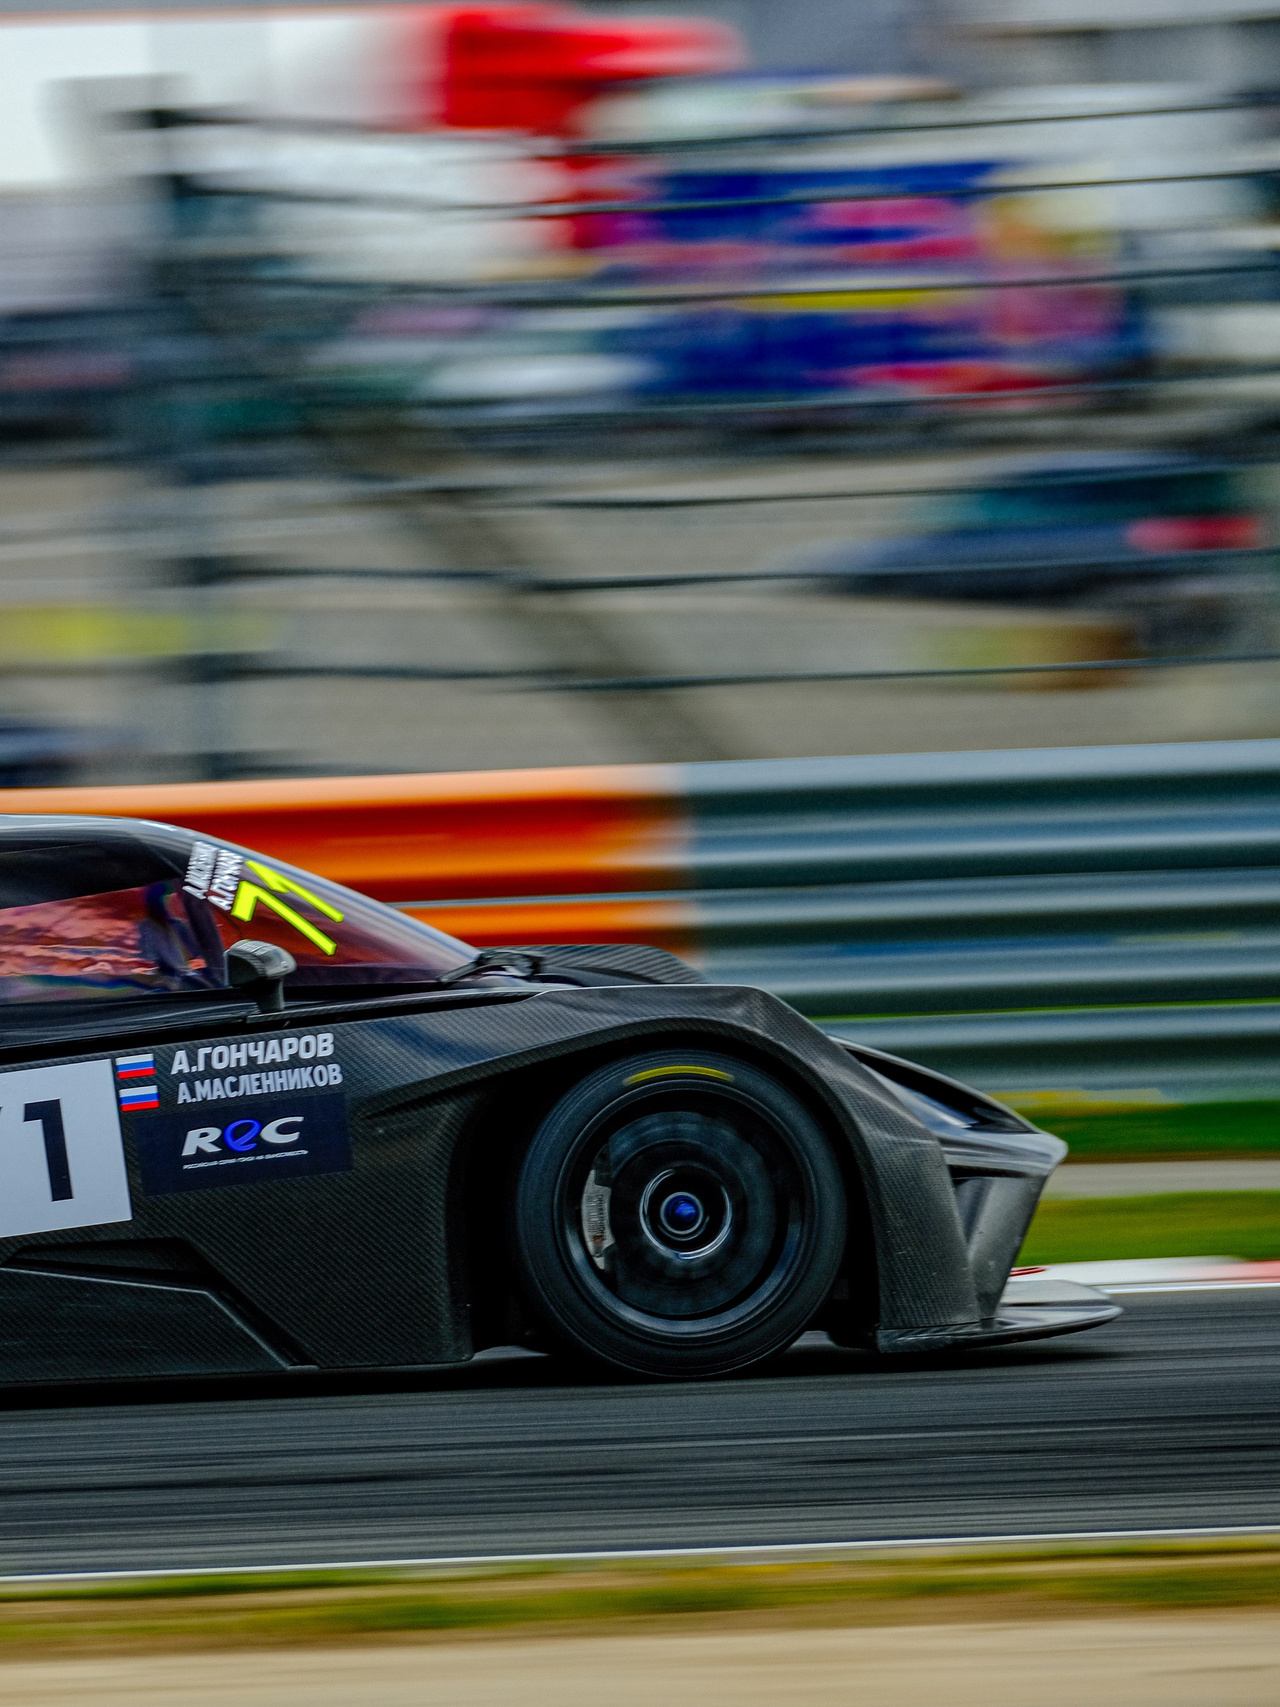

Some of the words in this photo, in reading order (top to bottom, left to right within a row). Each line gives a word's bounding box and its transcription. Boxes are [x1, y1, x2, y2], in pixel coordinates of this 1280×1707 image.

[230, 860, 344, 956] 71
[171, 1032, 335, 1075] А.ГОНЧАРОВ
[177, 1063, 343, 1105] А.МАСЛЕННИКОВ
